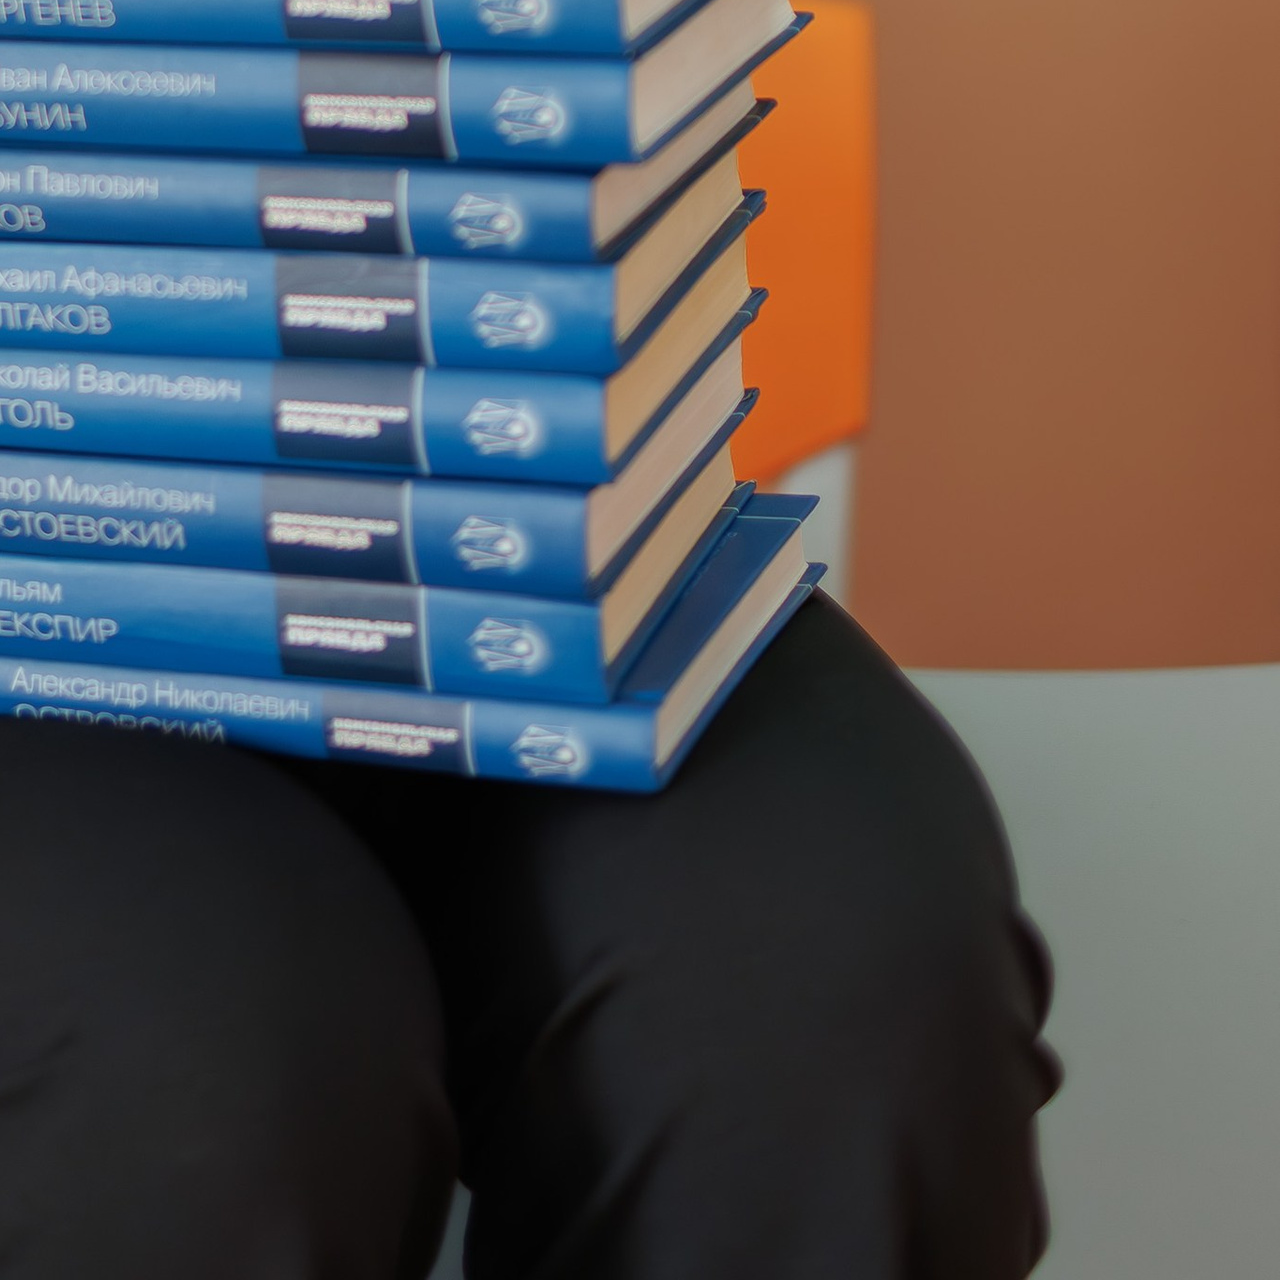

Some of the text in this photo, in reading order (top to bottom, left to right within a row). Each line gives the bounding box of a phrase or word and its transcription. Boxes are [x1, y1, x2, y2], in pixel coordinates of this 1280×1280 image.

[54, 62, 217, 97] Алексеевич
[25, 164, 160, 200] Павлович
[61, 264, 248, 300] Афанасьевич
[75, 362, 243, 402] Васильевич
[48, 473, 216, 515] Михайлович
[11, 665, 311, 723] Александр Николаевич
